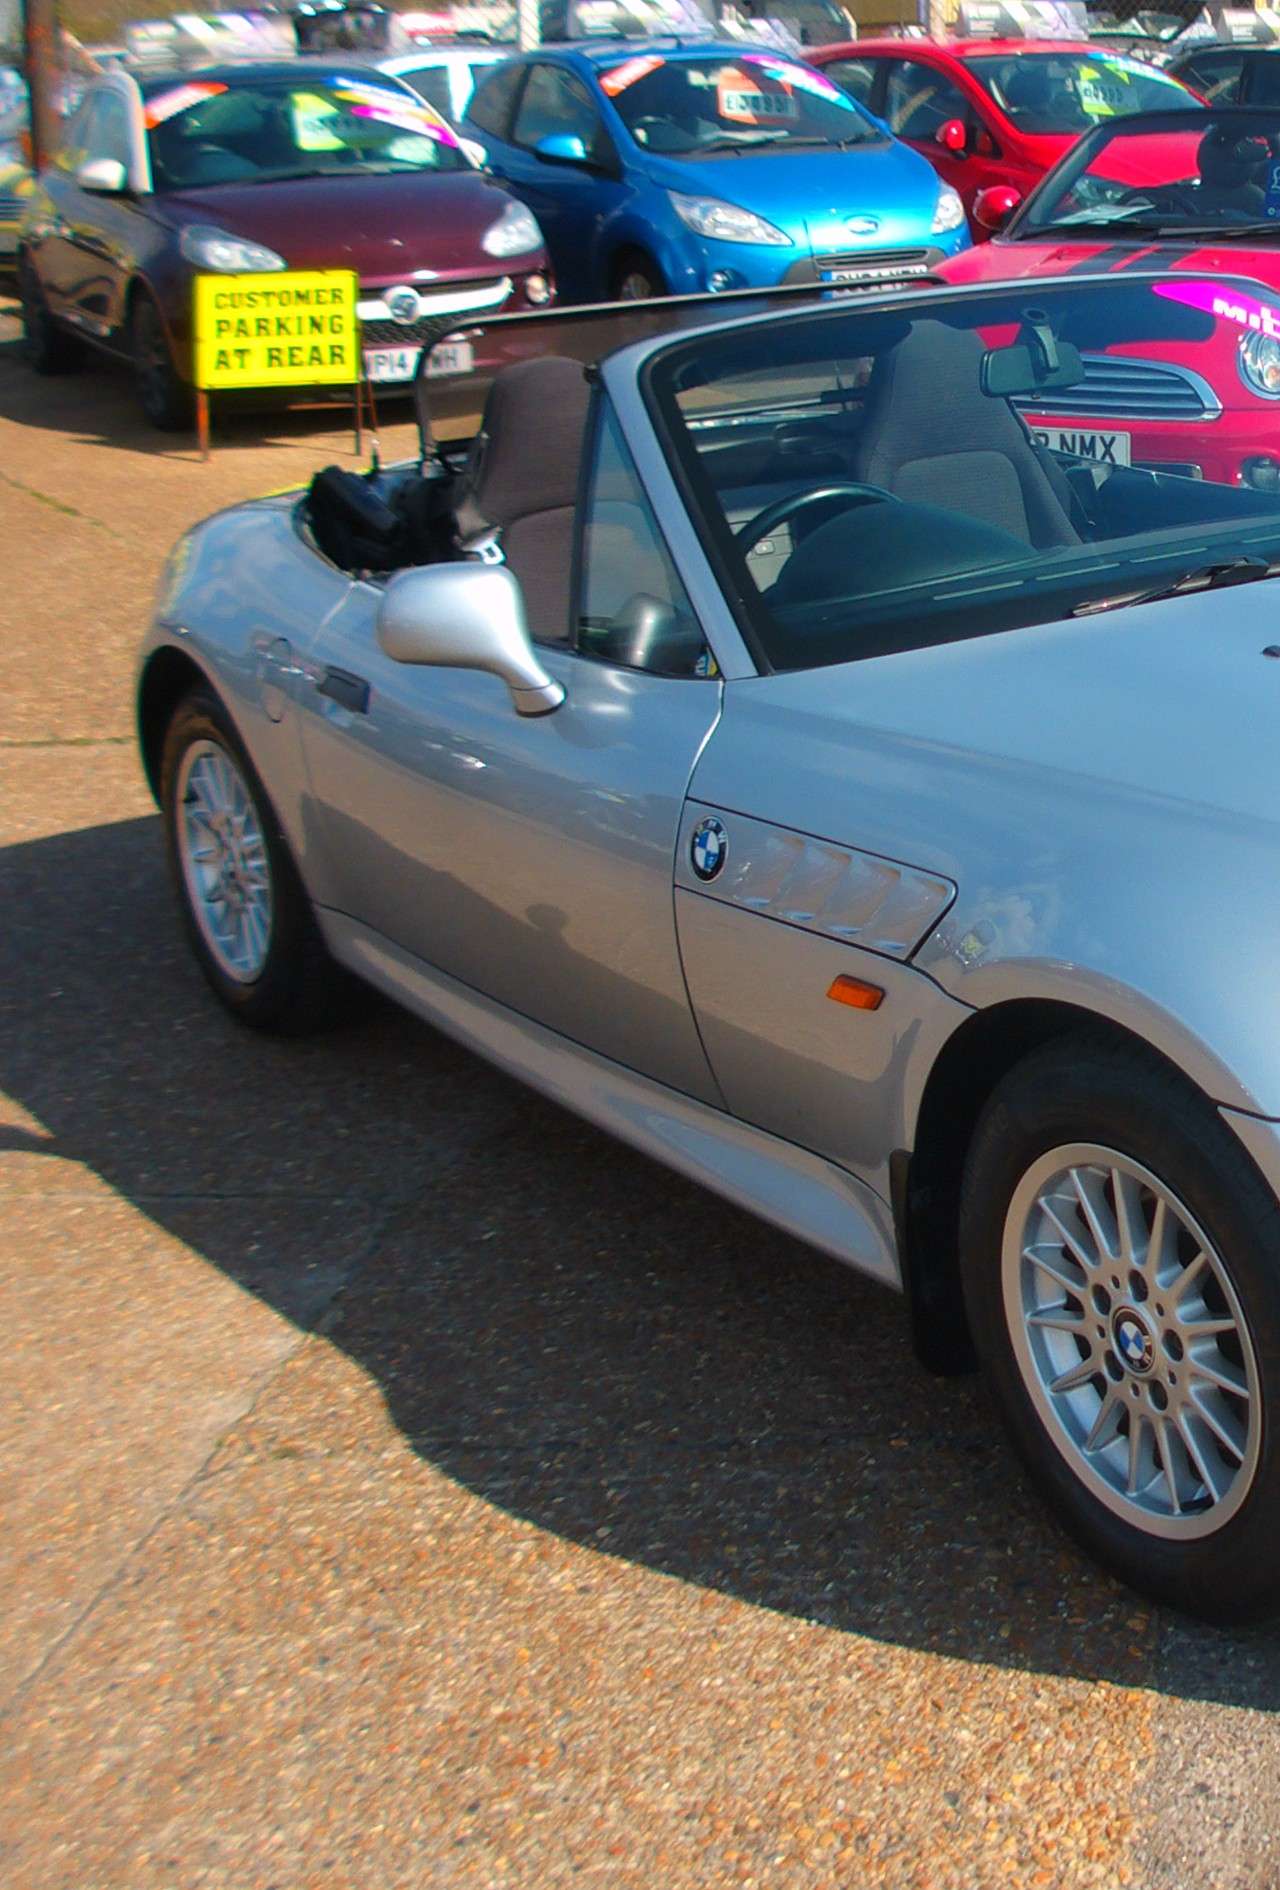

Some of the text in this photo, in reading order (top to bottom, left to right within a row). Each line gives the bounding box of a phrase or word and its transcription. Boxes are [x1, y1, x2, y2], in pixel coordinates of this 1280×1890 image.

[213, 287, 345, 310] CUSTOMER
[214, 314, 344, 339] PARKING
[213, 344, 346, 370] AT REAR
[1059, 432, 1117, 464] NMX
